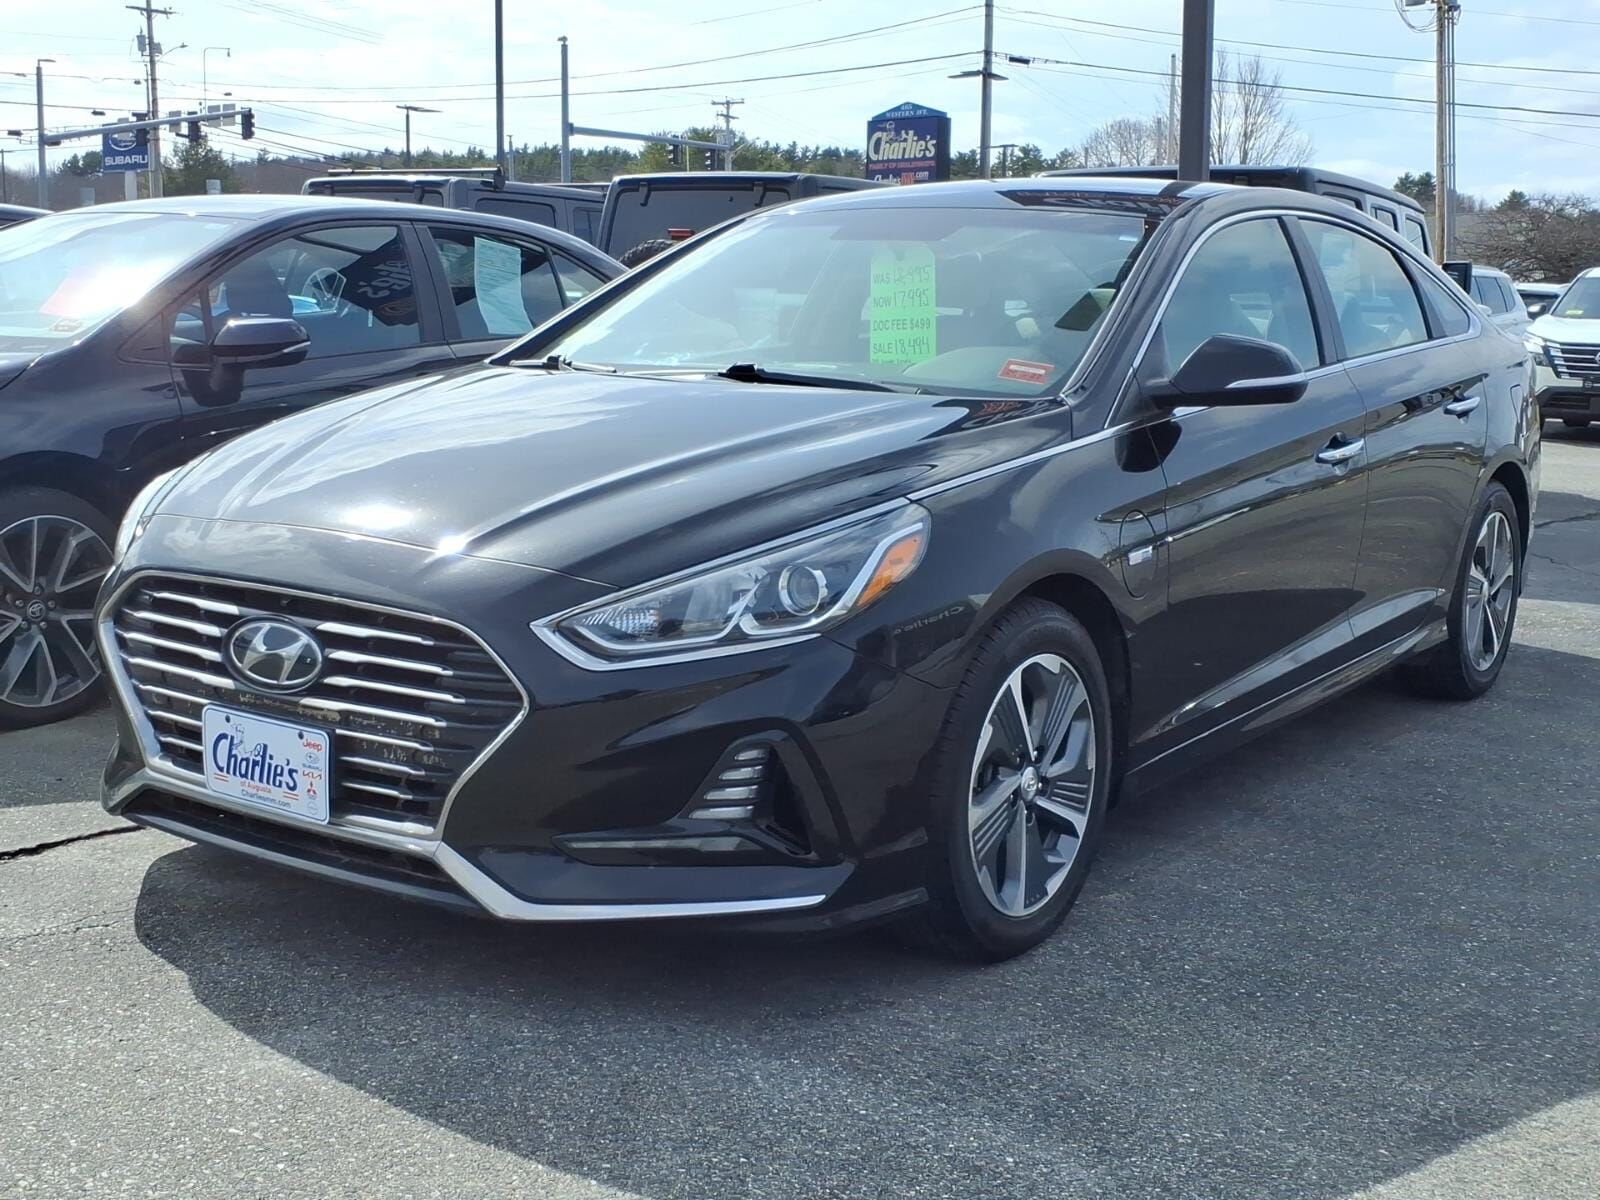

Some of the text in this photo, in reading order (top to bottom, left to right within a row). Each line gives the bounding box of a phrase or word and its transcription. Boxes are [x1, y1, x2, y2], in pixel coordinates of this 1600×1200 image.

[868, 130, 937, 161] Charlie's
[104, 155, 148, 166] SUBARU
[873, 272, 891, 285] WAS
[873, 296, 892, 309] NOW
[873, 318, 931, 331] DOC FEE $499
[873, 342, 894, 354] SALE
[302, 738, 323, 752] Jeep
[212, 732, 299, 792] Charlie's
